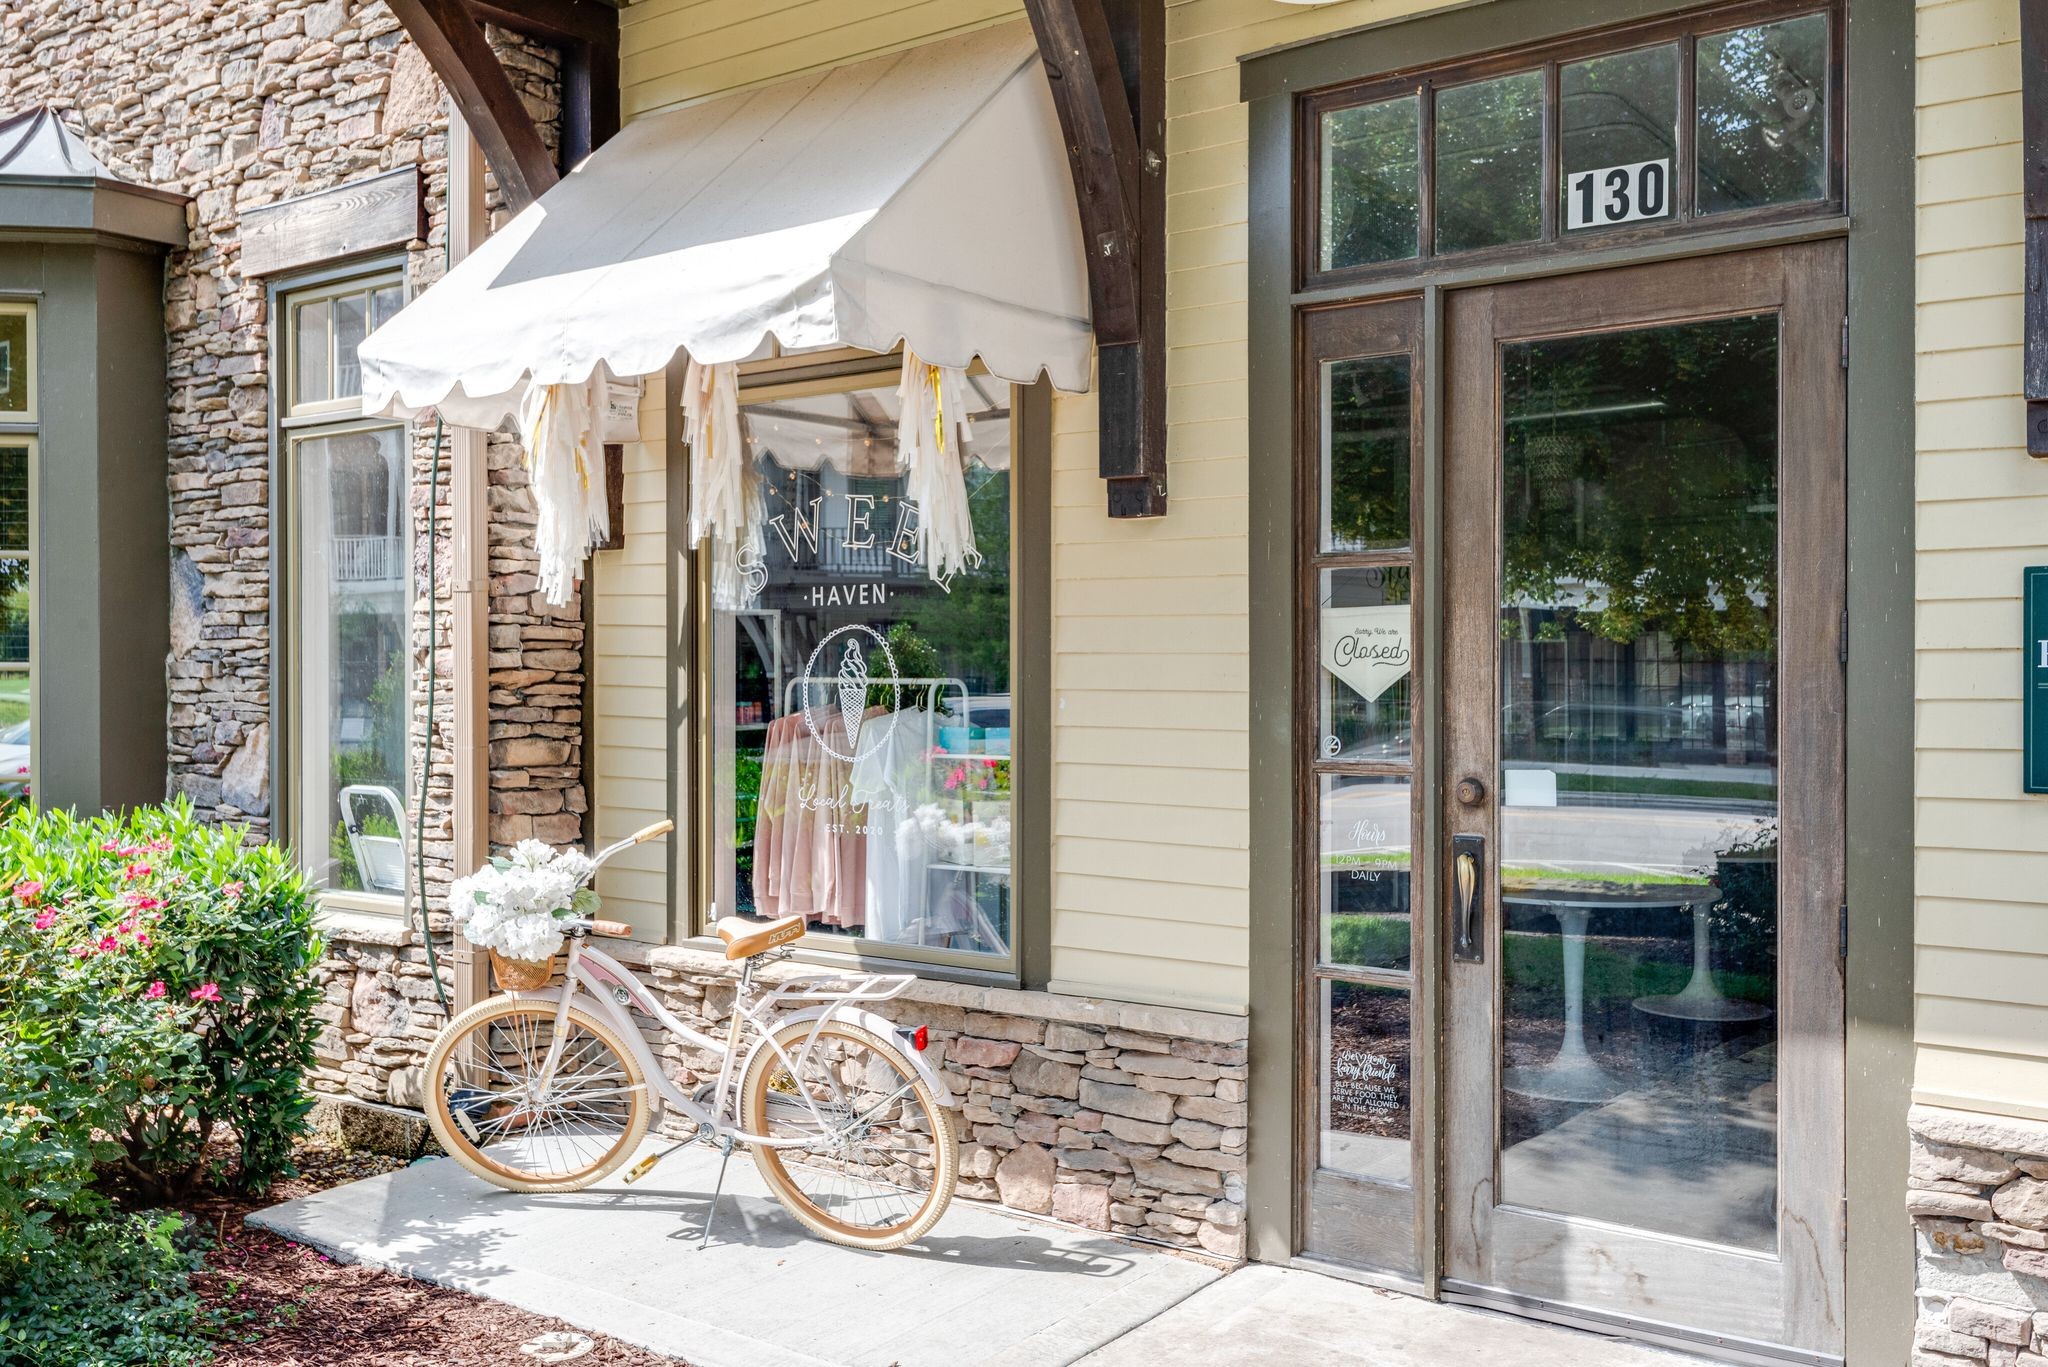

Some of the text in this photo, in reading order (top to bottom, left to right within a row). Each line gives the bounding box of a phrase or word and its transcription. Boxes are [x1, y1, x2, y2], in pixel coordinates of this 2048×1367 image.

[1576, 163, 1664, 224] 130
[812, 583, 886, 607] HAVEN
[1374, 627, 1386, 635] We
[1334, 635, 1409, 667] Closed
[798, 783, 910, 814] Local Treats
[824, 824, 884, 836] EST. 2020
[1348, 820, 1386, 848] Hours
[1374, 858, 1398, 871] 9PM
[1351, 869, 1381, 881] DAILY
[1366, 1054, 1390, 1069] your
[1363, 1064, 1396, 1084] friends
[1333, 1087, 1353, 1096] SERVE
[1379, 1093, 1398, 1102] THEY
[1335, 1080, 1395, 1094] BUT BECAUSE WE
[1347, 1096, 1363, 1104] NOT
[1365, 1099, 1399, 1109] ALLOWED
[1353, 1104, 1366, 1112] THE
[1369, 1106, 1389, 1115] SHOP
